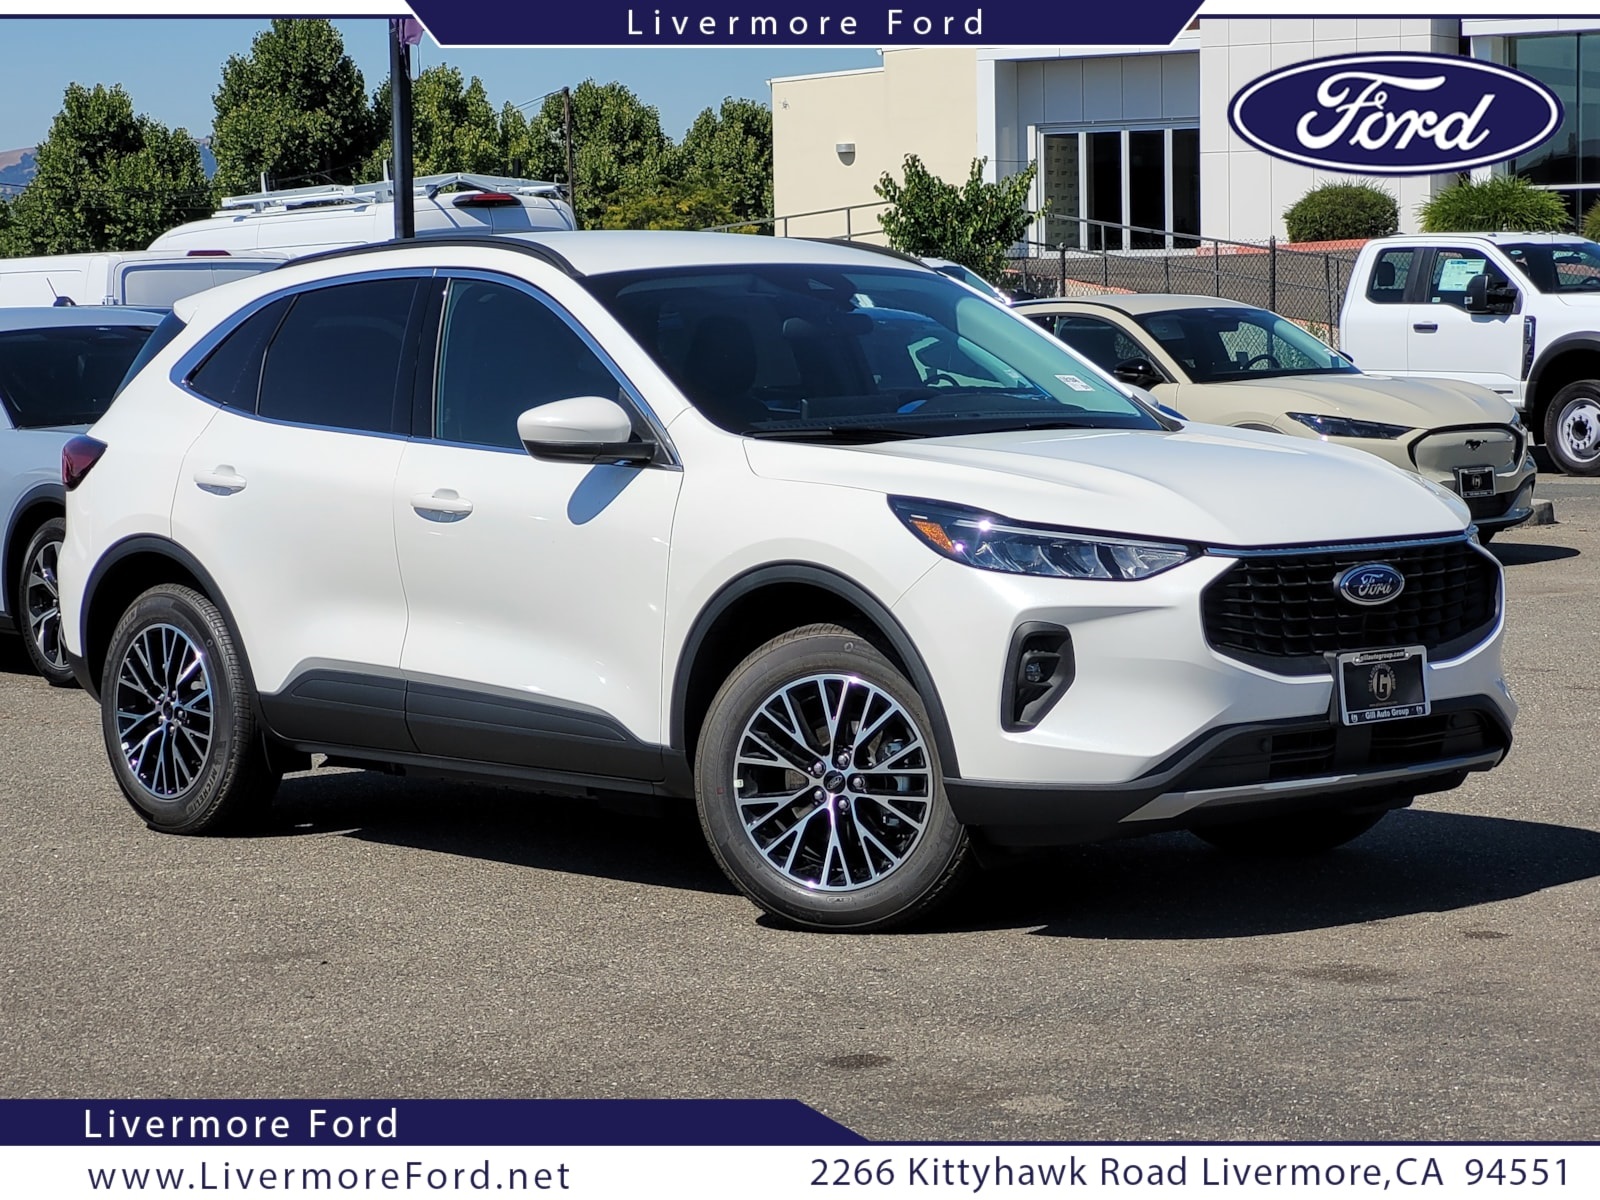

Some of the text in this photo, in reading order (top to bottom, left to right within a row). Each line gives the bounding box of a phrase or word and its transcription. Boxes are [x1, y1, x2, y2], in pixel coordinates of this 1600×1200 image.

[1358, 573, 1392, 597] Ford
[1377, 709, 1391, 718] Auto
[1391, 707, 1410, 717] Group
